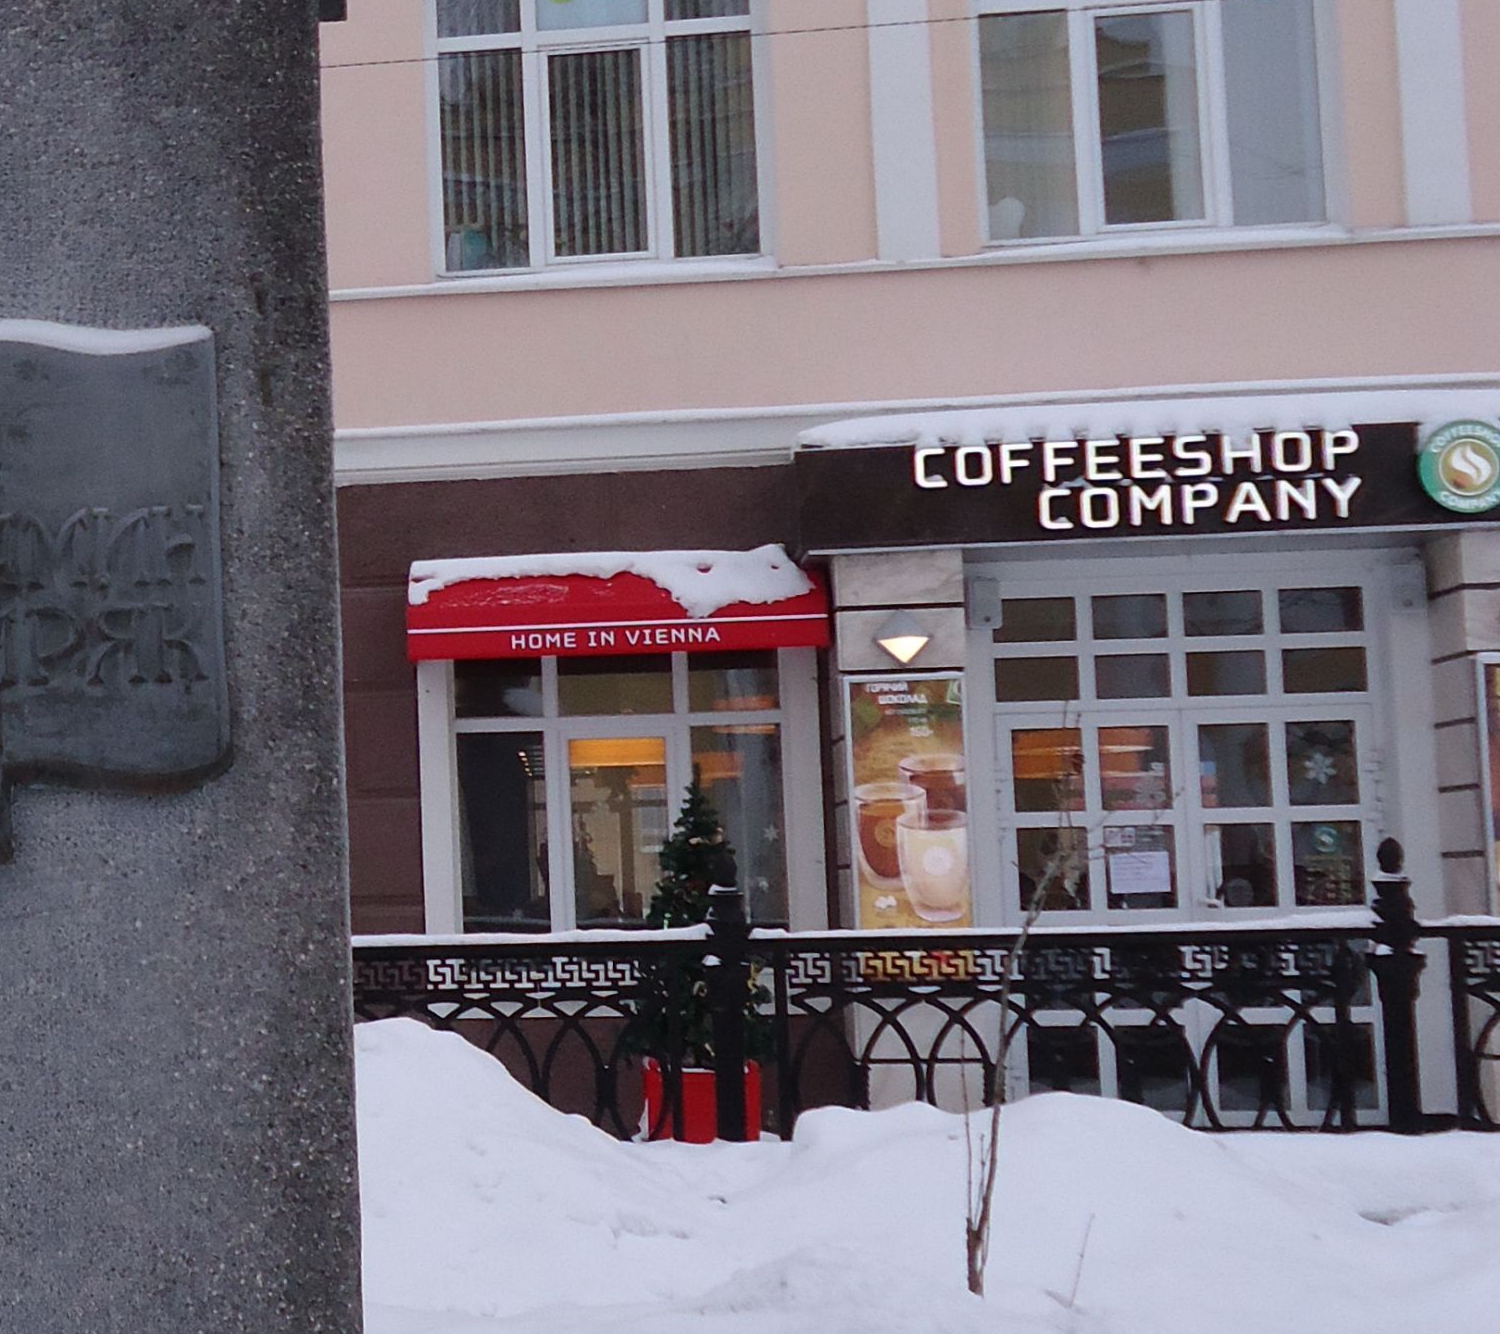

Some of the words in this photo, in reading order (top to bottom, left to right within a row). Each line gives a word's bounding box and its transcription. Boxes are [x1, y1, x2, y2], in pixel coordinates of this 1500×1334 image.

[914, 430, 1361, 489] COFFEESHOP
[1038, 476, 1363, 530] COMPANY
[511, 632, 577, 650] HOME
[588, 631, 615, 647] IN
[625, 626, 722, 646] VIENNA
